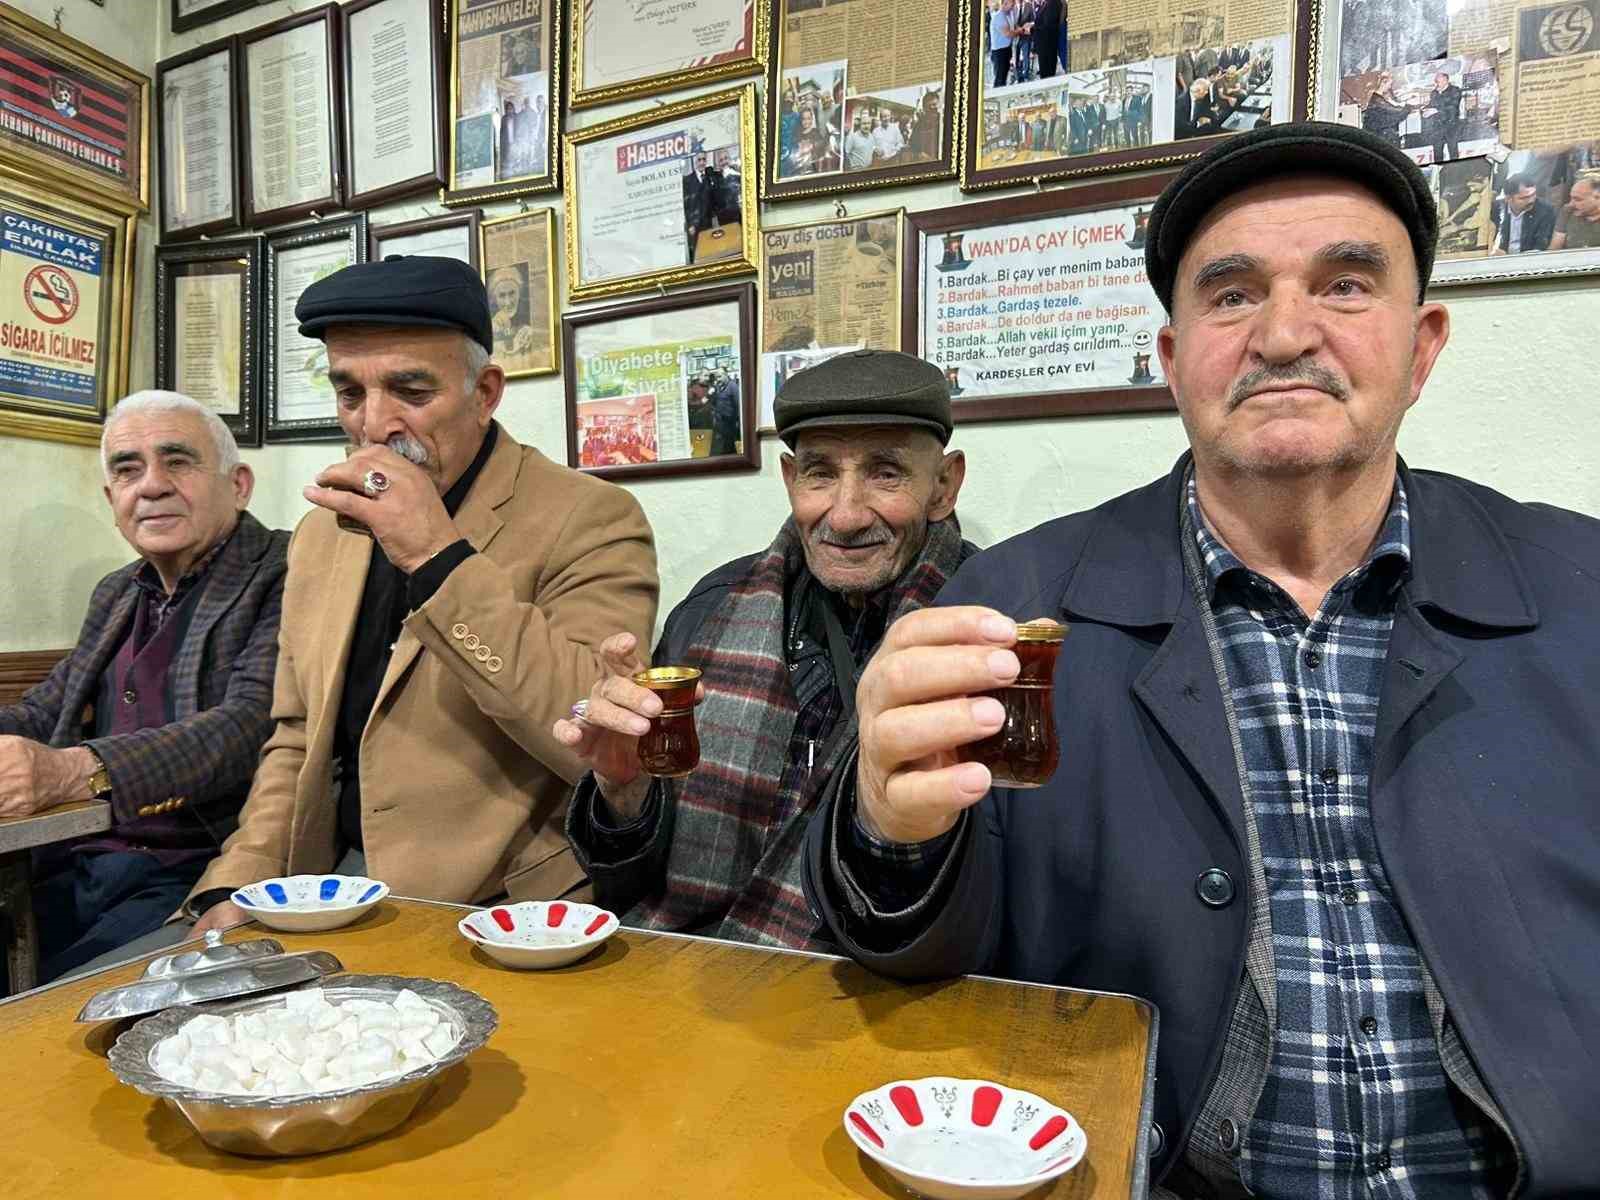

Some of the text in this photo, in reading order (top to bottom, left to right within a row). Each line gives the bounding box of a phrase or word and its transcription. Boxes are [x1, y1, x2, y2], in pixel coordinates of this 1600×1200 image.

[816, 223, 854, 240] dostu
[969, 223, 1126, 258] WAN'DA ÇAY İÇMEK
[4, 230, 96, 265] EMLAK
[771, 255, 811, 283] yeni
[1013, 268, 1034, 282] çay
[1038, 266, 1056, 277] ver
[1060, 259, 1101, 274] menim
[1105, 256, 1147, 270] baban
[1046, 279, 1084, 293] baban
[1088, 275, 1099, 288] bi
[1103, 275, 1130, 287] tane
[1044, 294, 1082, 309] tezele.
[1015, 312, 1055, 327] doldur
[1059, 310, 1073, 322] da
[1077, 309, 1091, 320] ne
[1, 320, 45, 354] SİGARA
[1030, 326, 1057, 341] vekil
[1061, 324, 1086, 340] içim
[1029, 341, 1069, 358] gardaş
[592, 349, 673, 376] Diyabete
[976, 360, 1095, 381] KARDEŞLER ÇAY EVİ
